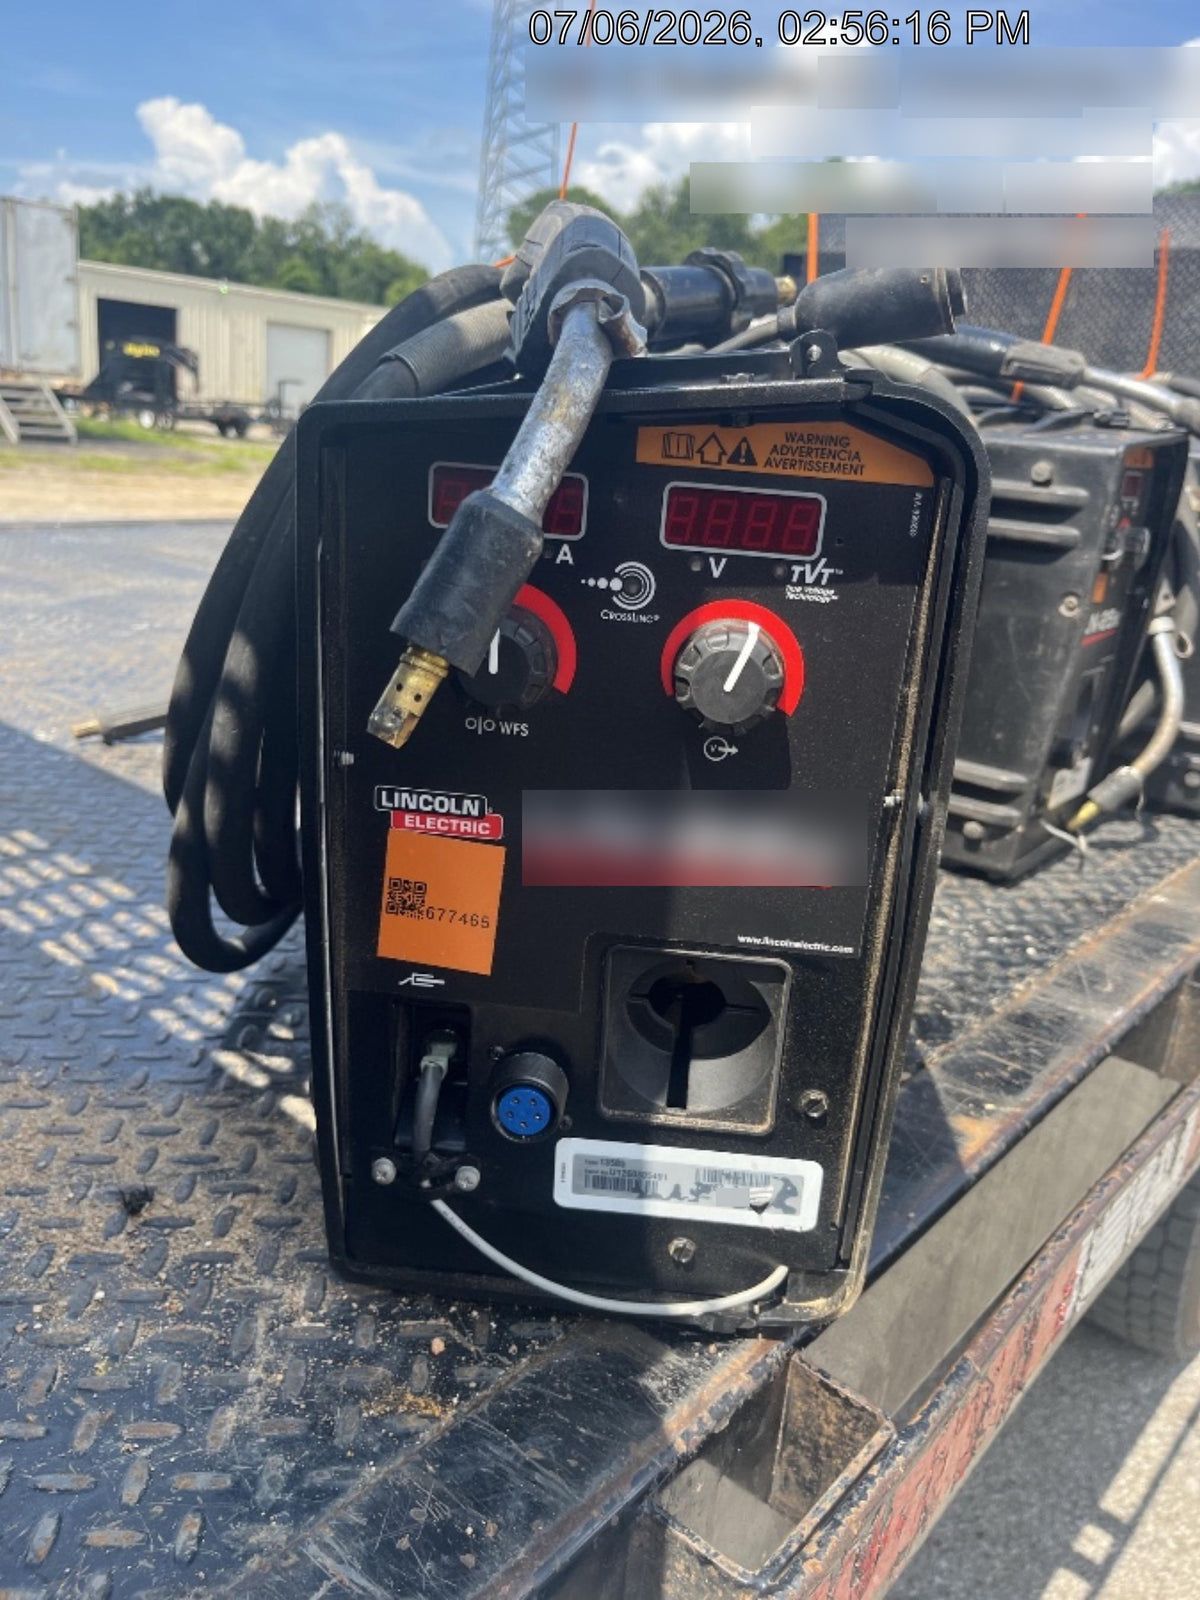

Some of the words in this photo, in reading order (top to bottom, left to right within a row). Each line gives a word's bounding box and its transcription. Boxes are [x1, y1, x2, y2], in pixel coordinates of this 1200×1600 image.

[784, 431, 850, 448] WARNING
[768, 444, 862, 463] ADVERTENCIA
[763, 458, 865, 476] AVERTISSEMENT
[555, 544, 574, 565] A
[709, 557, 727, 579] V
[500, 721, 529, 737] WFS
[381, 790, 480, 816] LINCOLN
[404, 814, 491, 835] ELECTRIC
[737, 935, 854, 954] www.lincolnelectric.com
